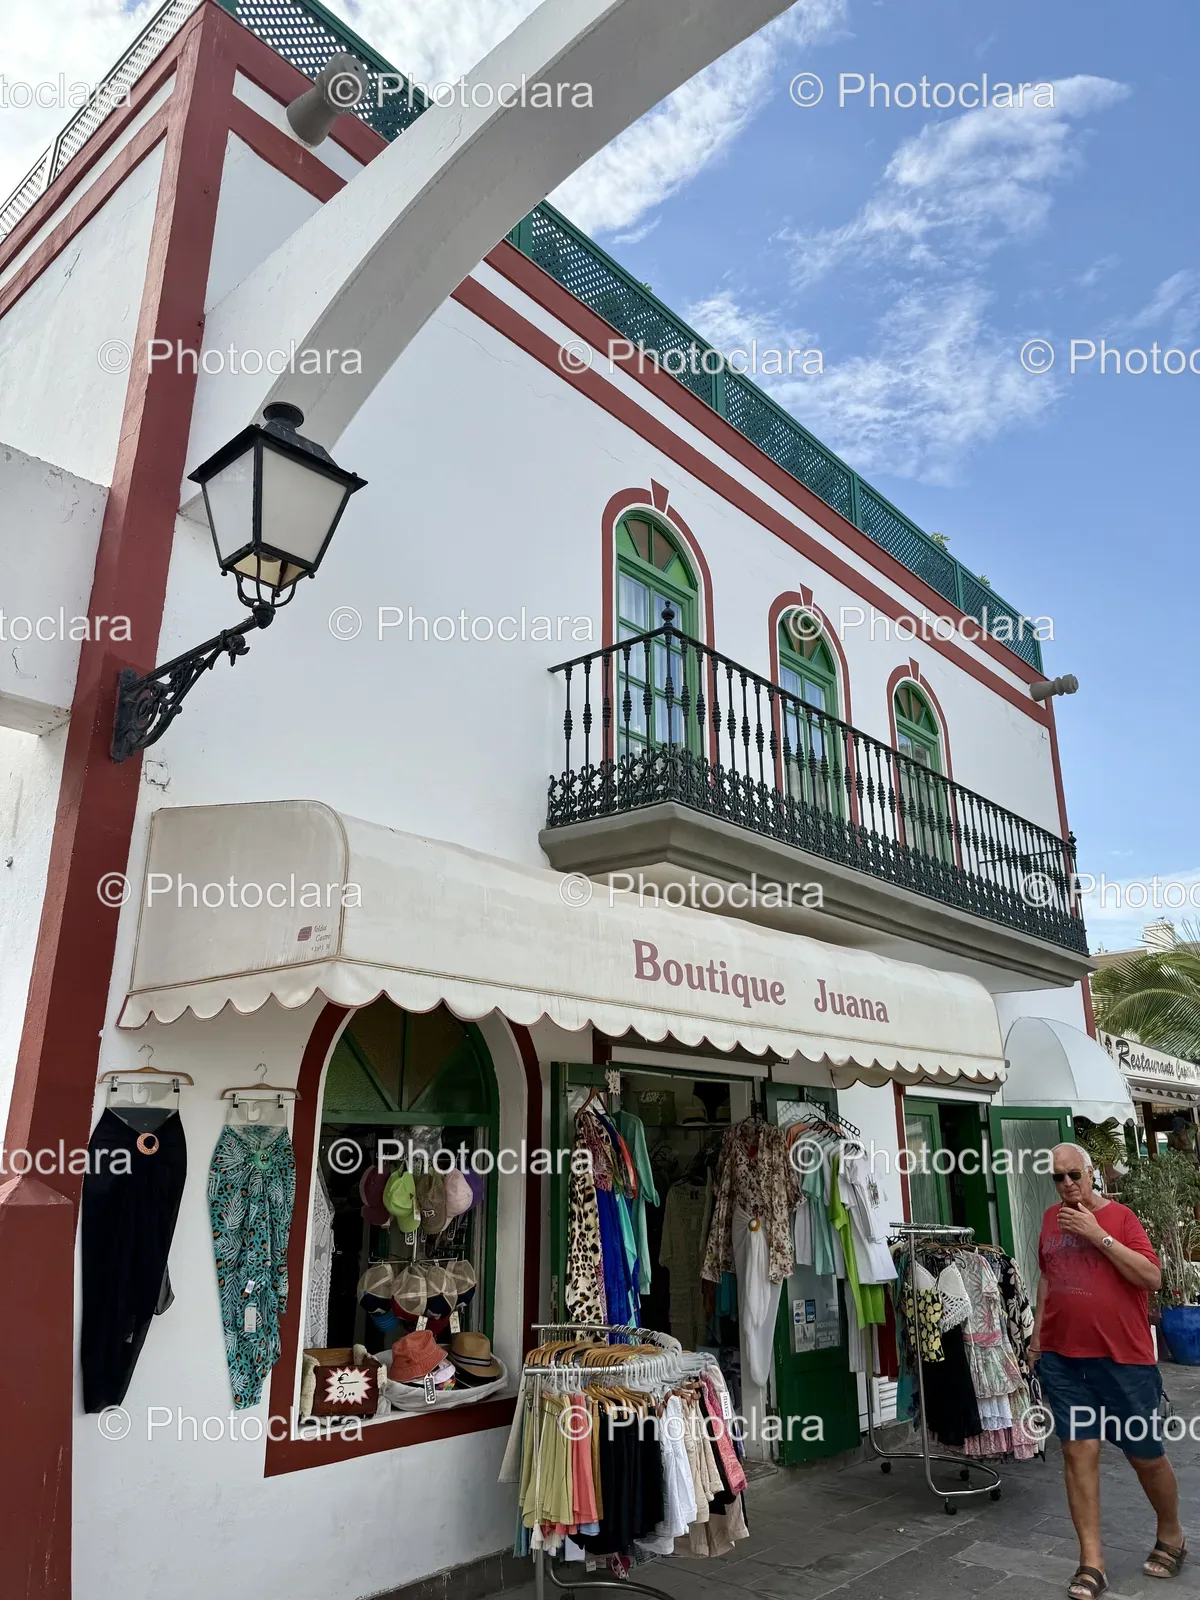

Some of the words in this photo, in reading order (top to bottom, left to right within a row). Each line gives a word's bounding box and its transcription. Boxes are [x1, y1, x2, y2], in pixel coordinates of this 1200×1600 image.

[632, 938, 787, 1009] Boutique
[813, 978, 890, 1023] Juana
[1115, 1039, 1175, 1077] Restaurante
